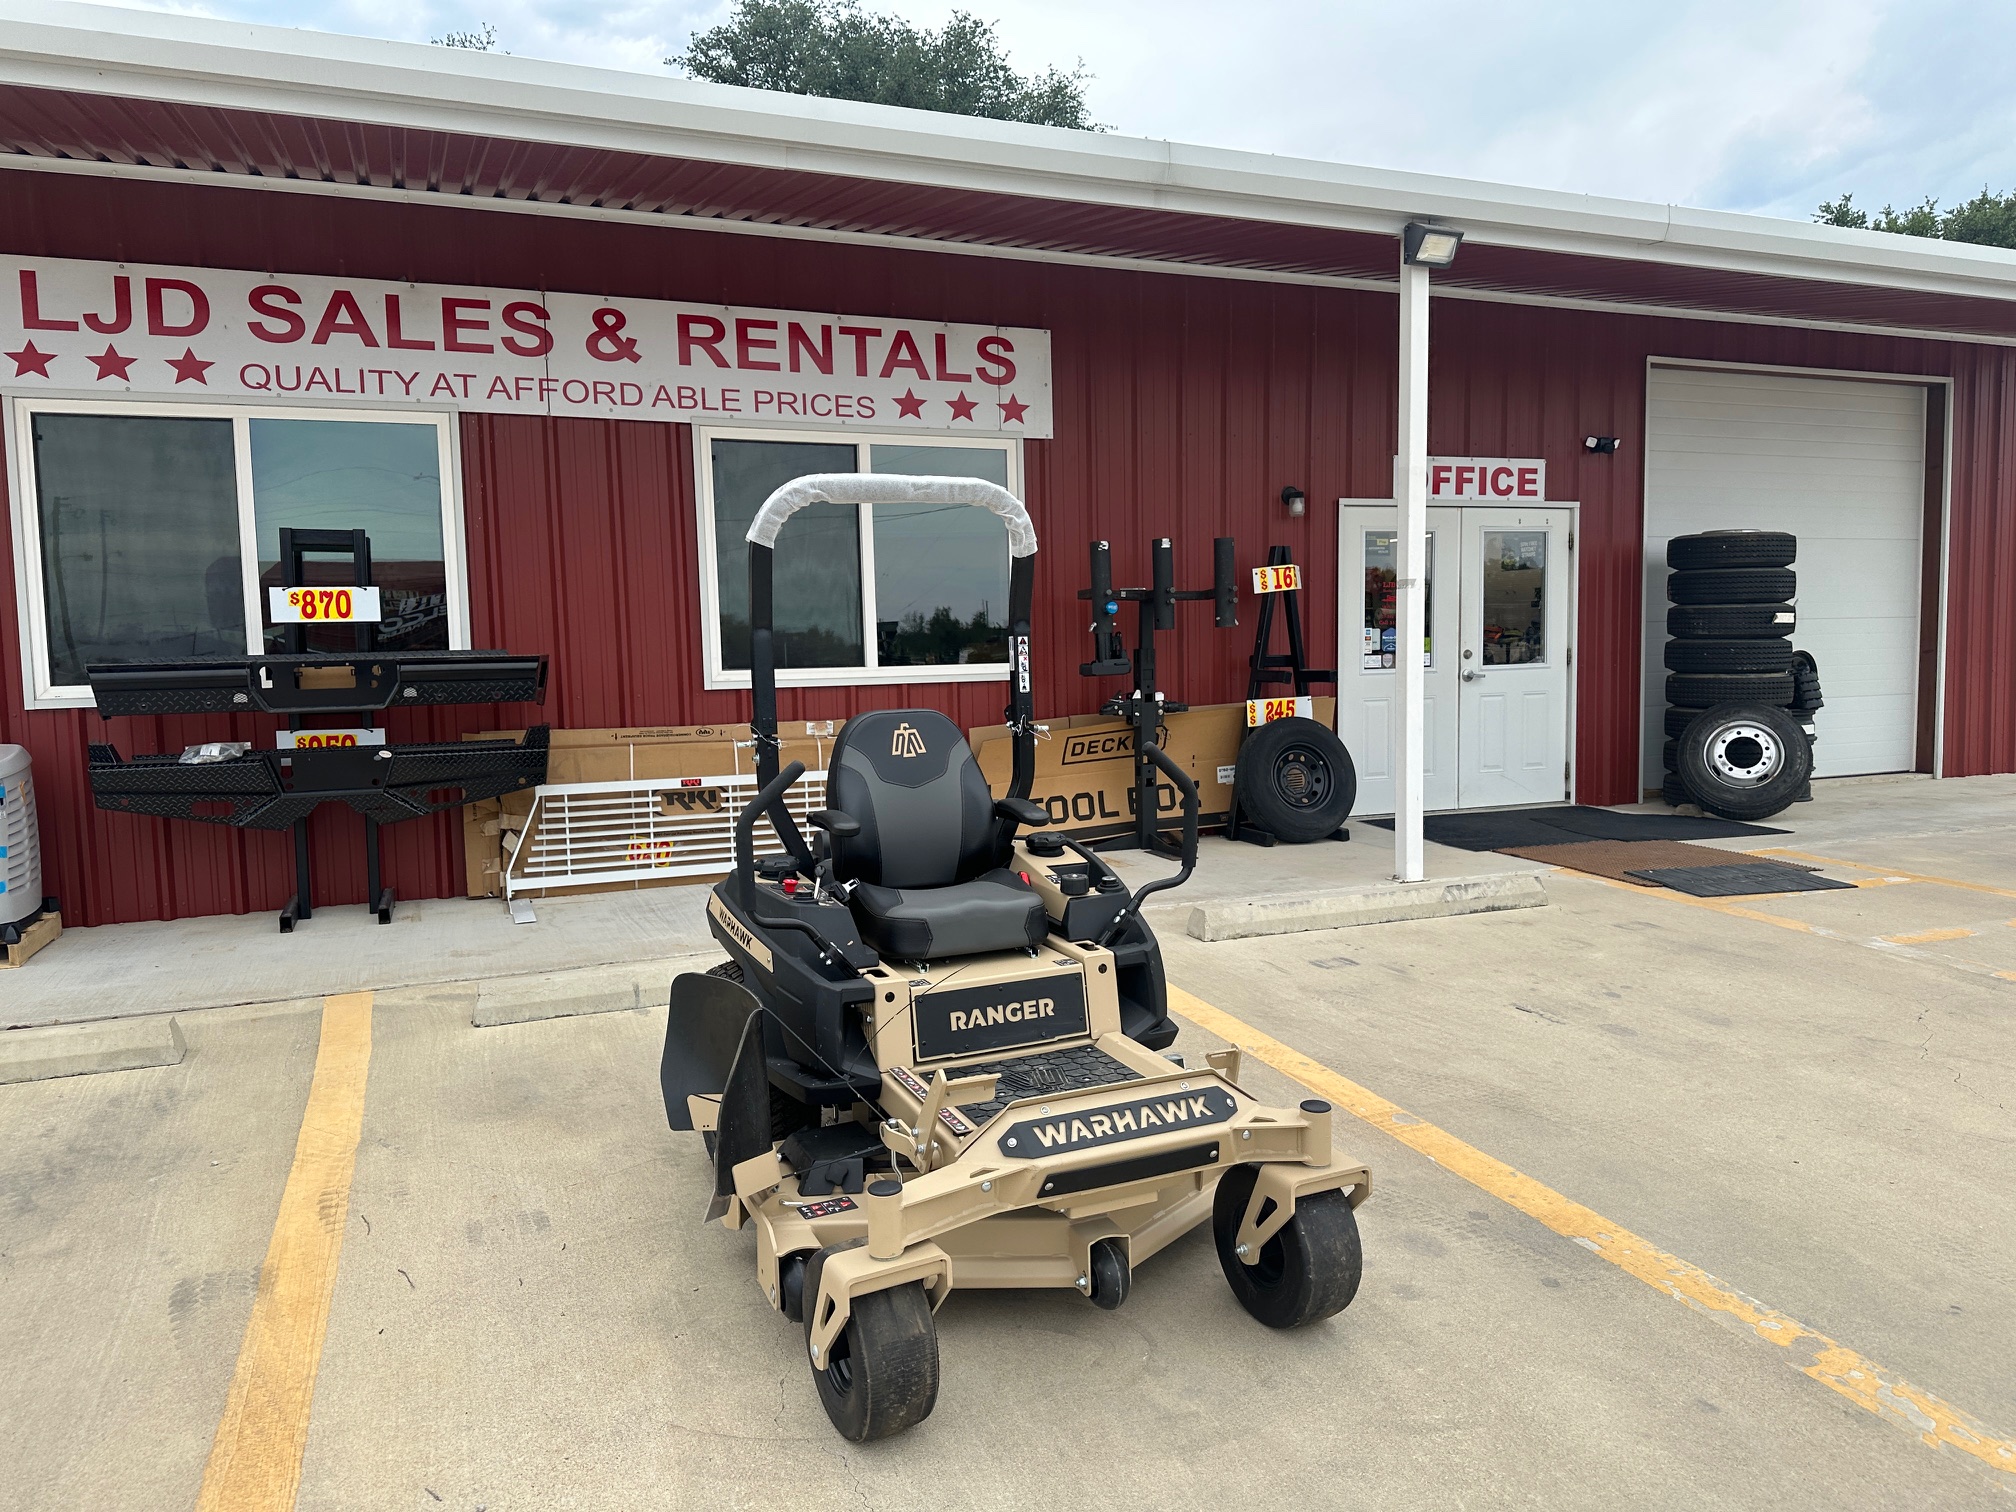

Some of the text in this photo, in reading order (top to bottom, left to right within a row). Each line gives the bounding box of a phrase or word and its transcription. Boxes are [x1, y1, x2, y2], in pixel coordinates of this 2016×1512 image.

[19, 269, 1017, 386] LJD SALES & RENTALS
[239, 363, 420, 398] QUALITY
[429, 373, 477, 399] AT
[754, 390, 876, 419] PRICES
[1426, 465, 1538, 497] FFICE
[290, 590, 352, 619] $870
[662, 790, 717, 811] RKI
[719, 906, 753, 950] WARHAWK
[950, 998, 1055, 1031] RANGER
[1032, 1095, 1217, 1148] WARHAWK
